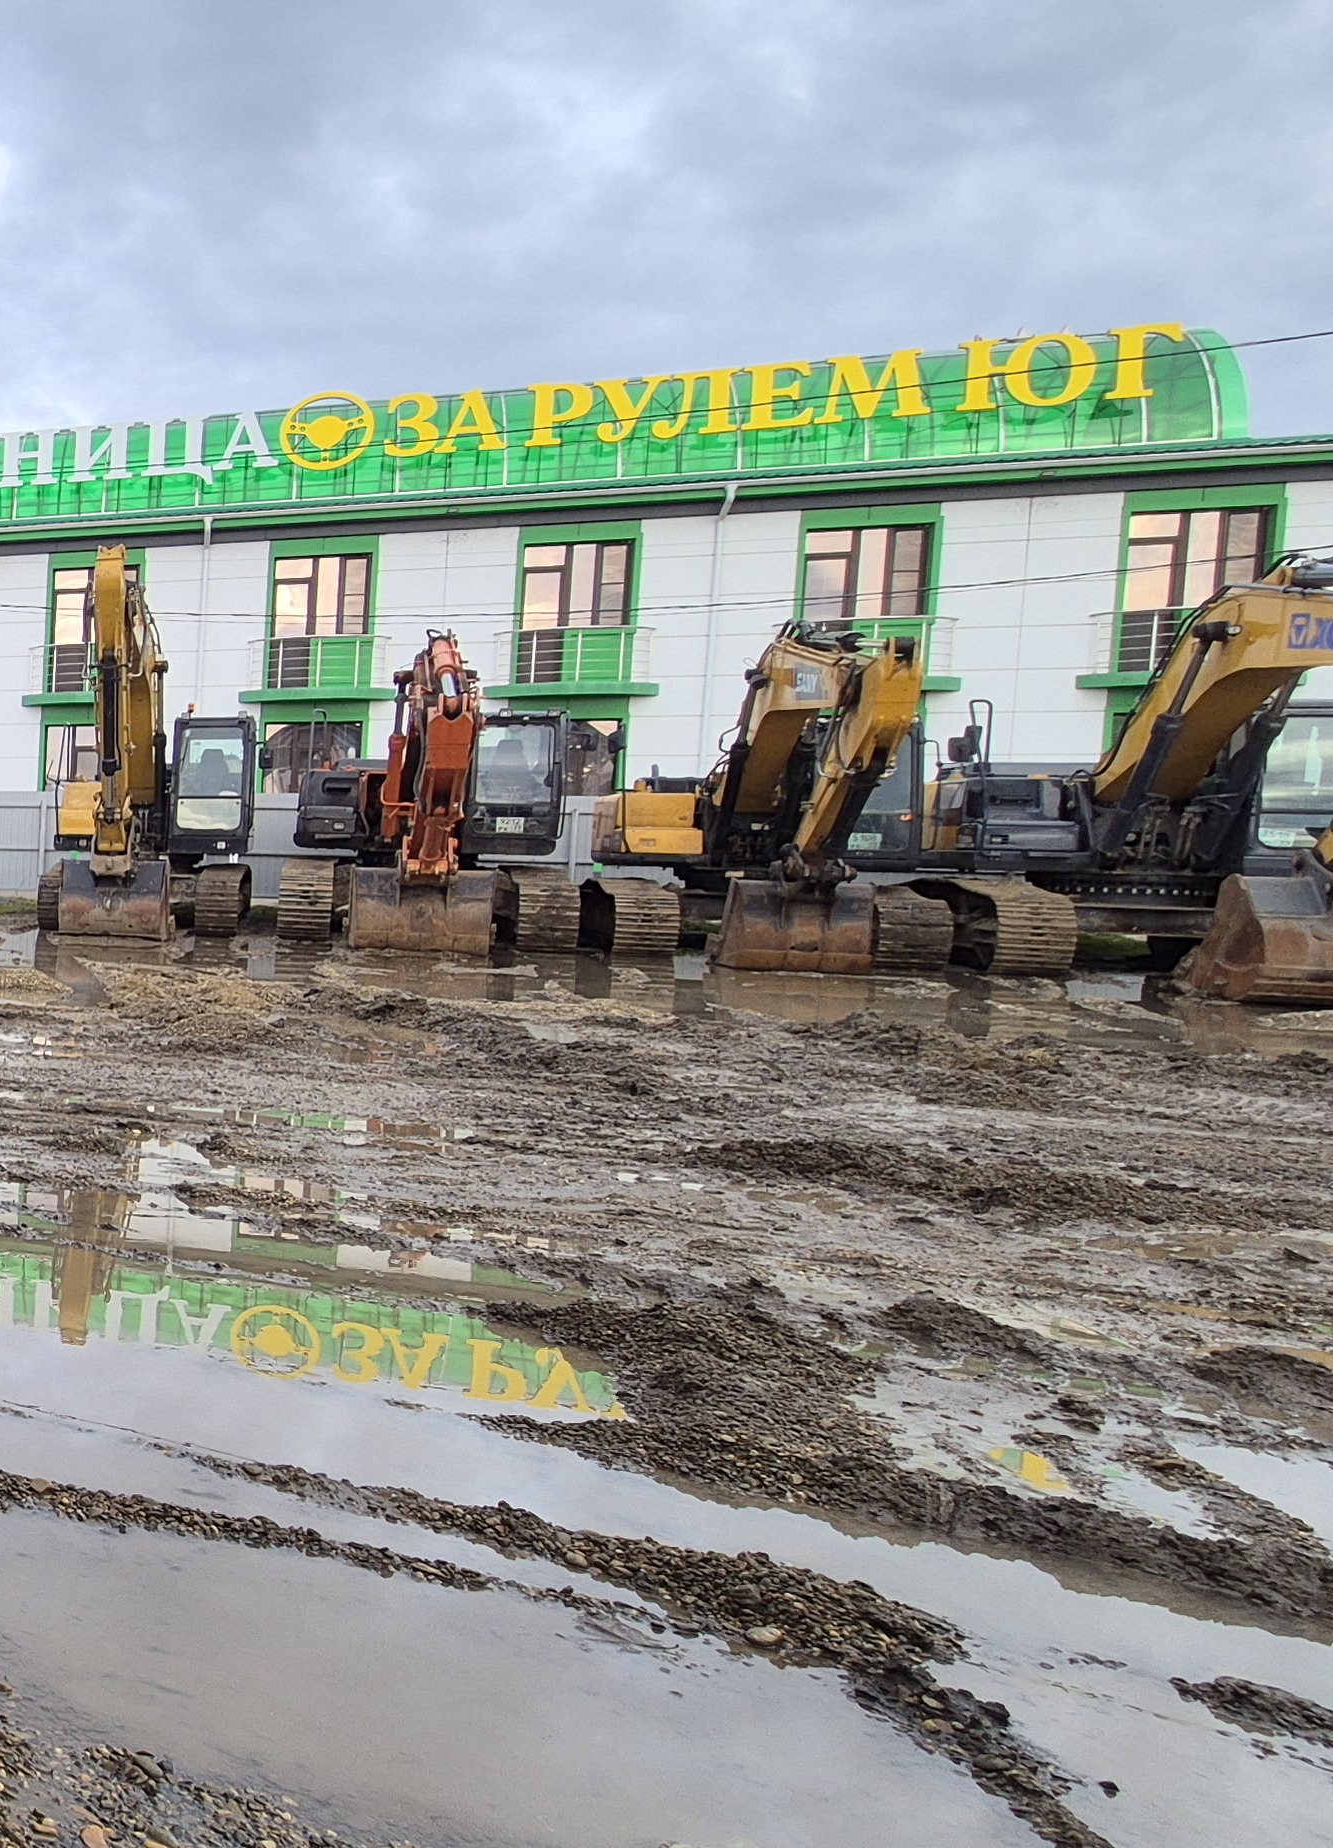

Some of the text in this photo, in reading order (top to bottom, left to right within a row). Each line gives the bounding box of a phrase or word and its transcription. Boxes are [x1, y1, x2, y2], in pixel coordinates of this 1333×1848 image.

[383, 390, 507, 457] ЗА
[524, 348, 928, 447] РУЛЕМ
[956, 322, 1185, 413] ЮГ
